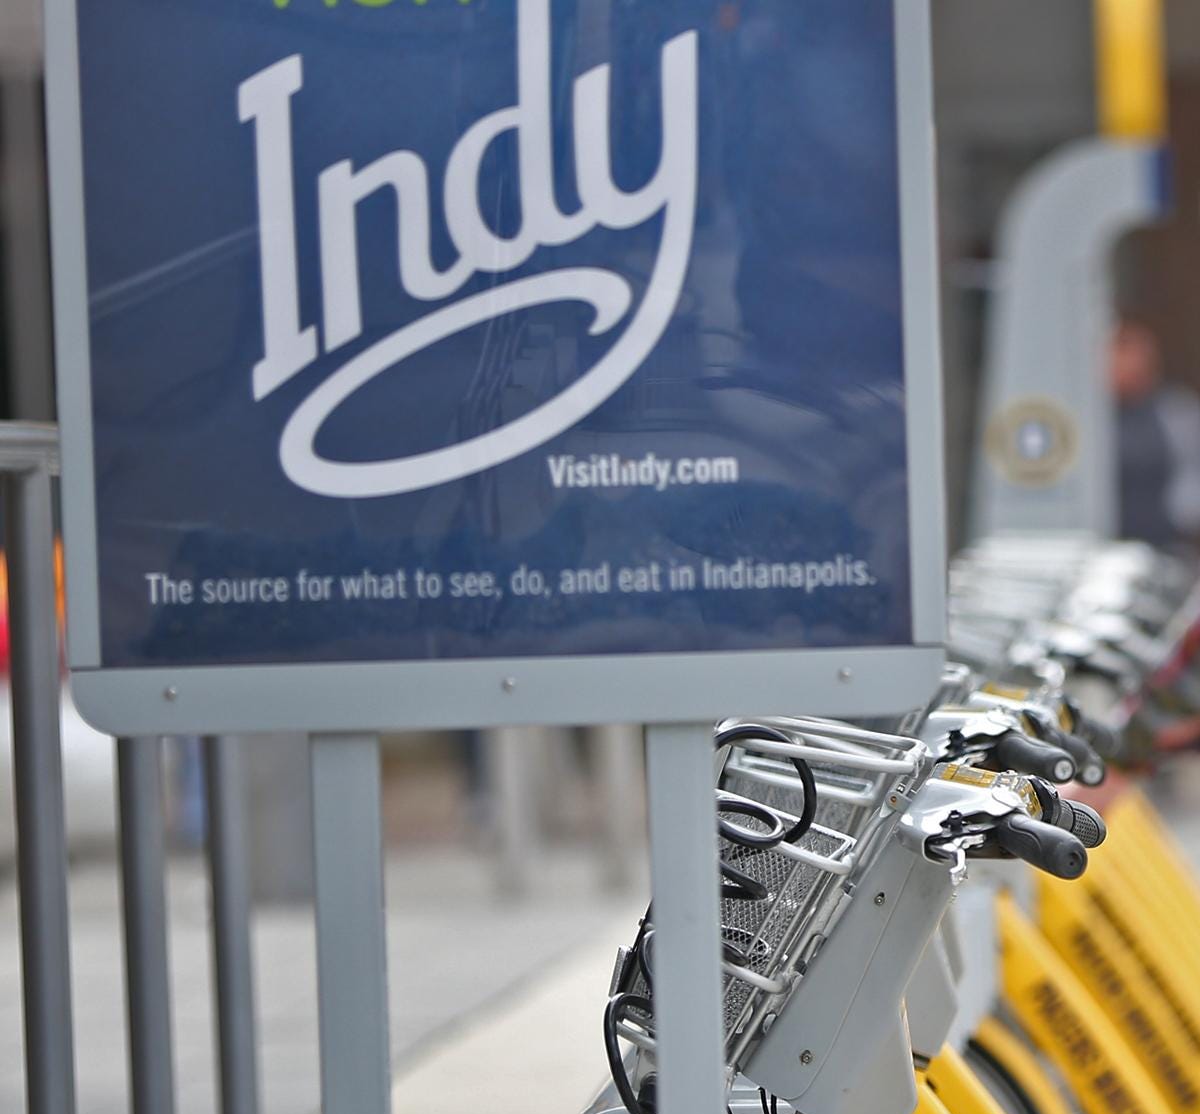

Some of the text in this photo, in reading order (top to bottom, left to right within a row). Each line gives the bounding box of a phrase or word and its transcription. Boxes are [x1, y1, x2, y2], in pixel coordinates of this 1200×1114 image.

[238, 0, 700, 498] Indy
[547, 452, 740, 492] VisitIndy.com
[145, 553, 877, 605] The source for what to see, do, and eat in Indianapolis.
